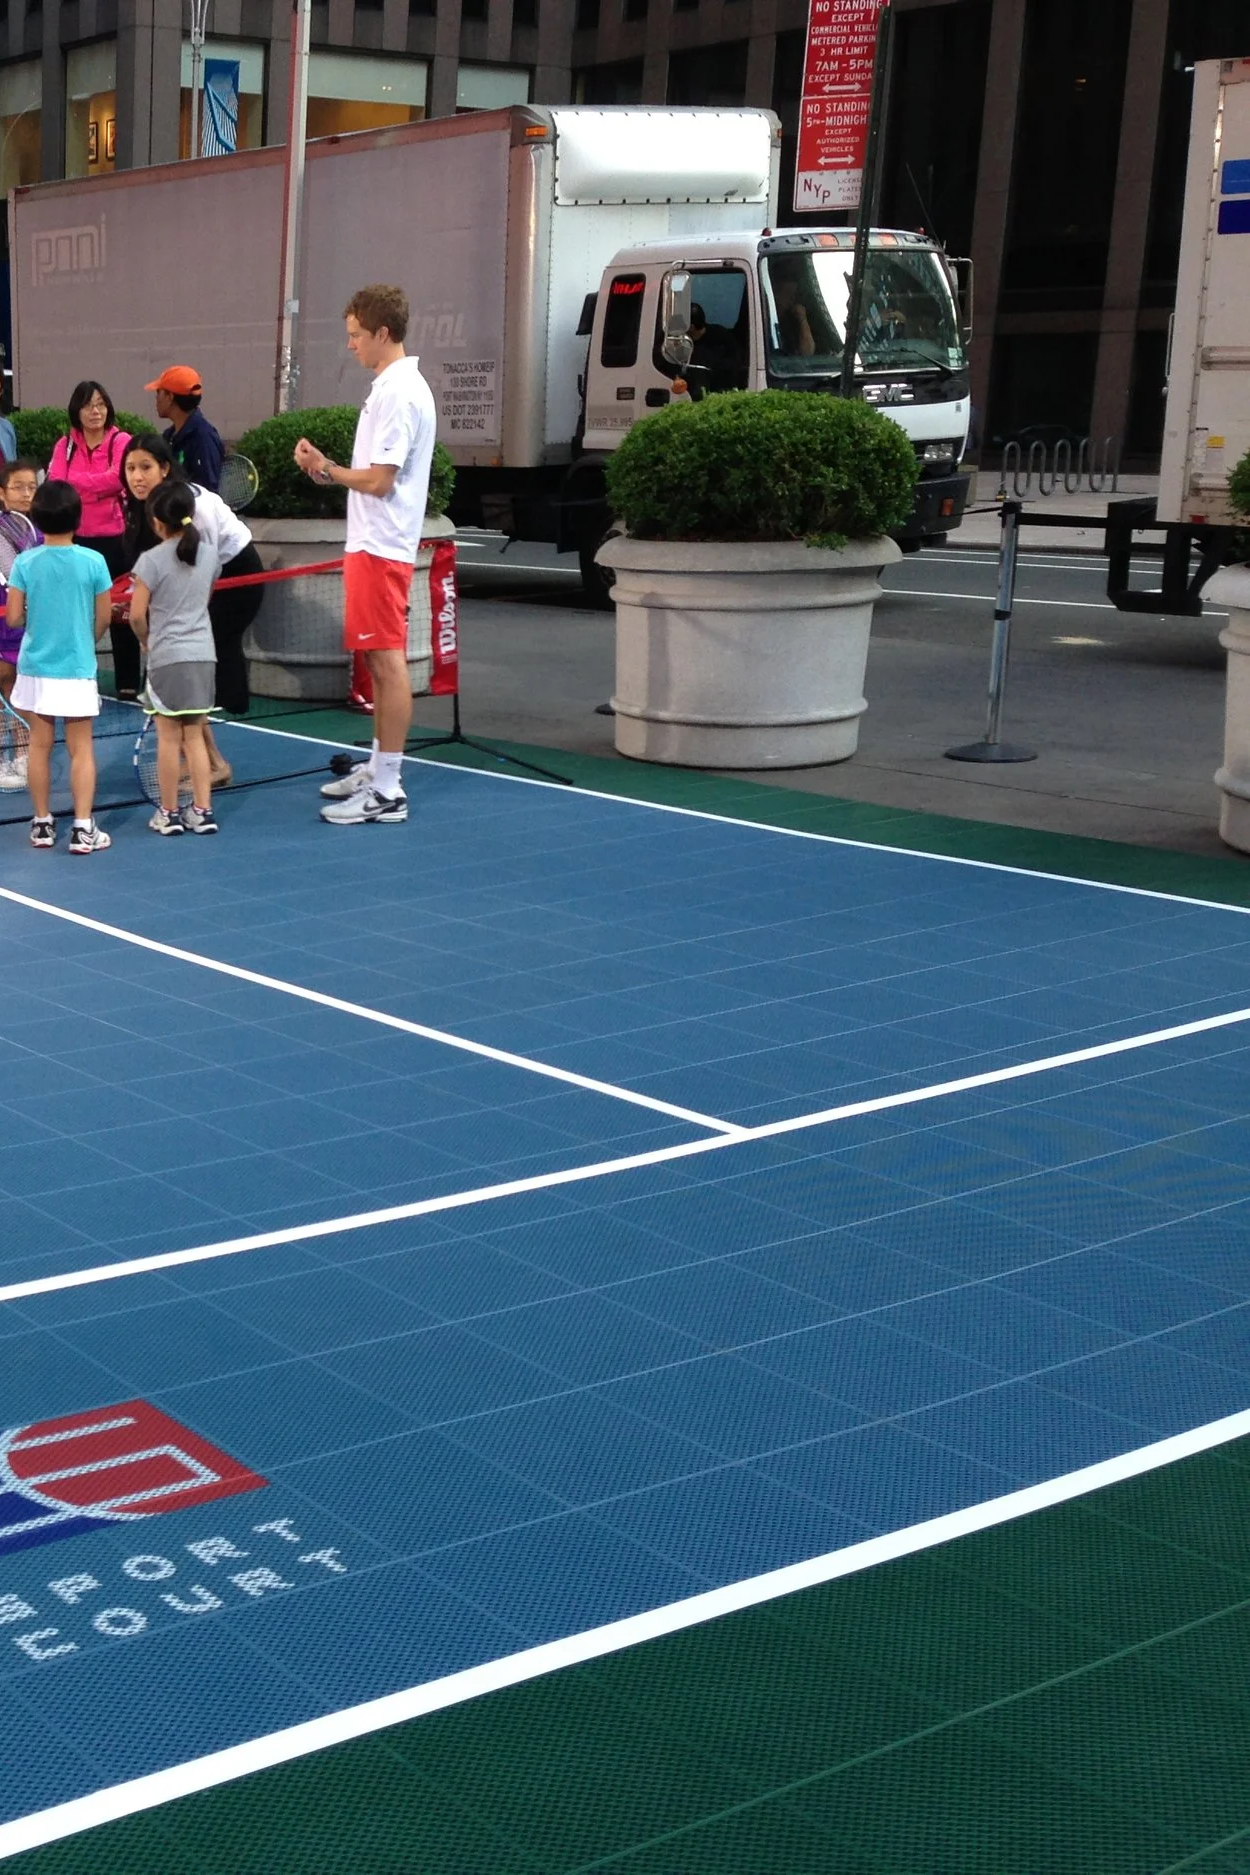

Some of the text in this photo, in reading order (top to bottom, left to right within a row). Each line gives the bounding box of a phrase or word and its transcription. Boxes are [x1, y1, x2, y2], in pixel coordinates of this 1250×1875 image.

[815, 1, 830, 12] NO
[831, 13, 865, 23] EXCEPT
[811, 23, 878, 35] COMMERCIAL VEHICL
[811, 34, 876, 46] METERED PARKIN
[820, 46, 869, 57] 3 HR LIMIT
[815, 61, 839, 72] 7AM
[849, 59, 874, 70] 5PM
[808, 73, 873, 84] EXCEPT SUNDA
[806, 103, 821, 115] NO
[825, 128, 852, 136] EXCEPT
[816, 136, 860, 145] AUTHORIZED
[862, 383, 915, 402] GMC
[452, 404, 466, 416] DOT
[438, 573, 457, 654] Wilson
[12, 1547, 348, 1661] COURT
